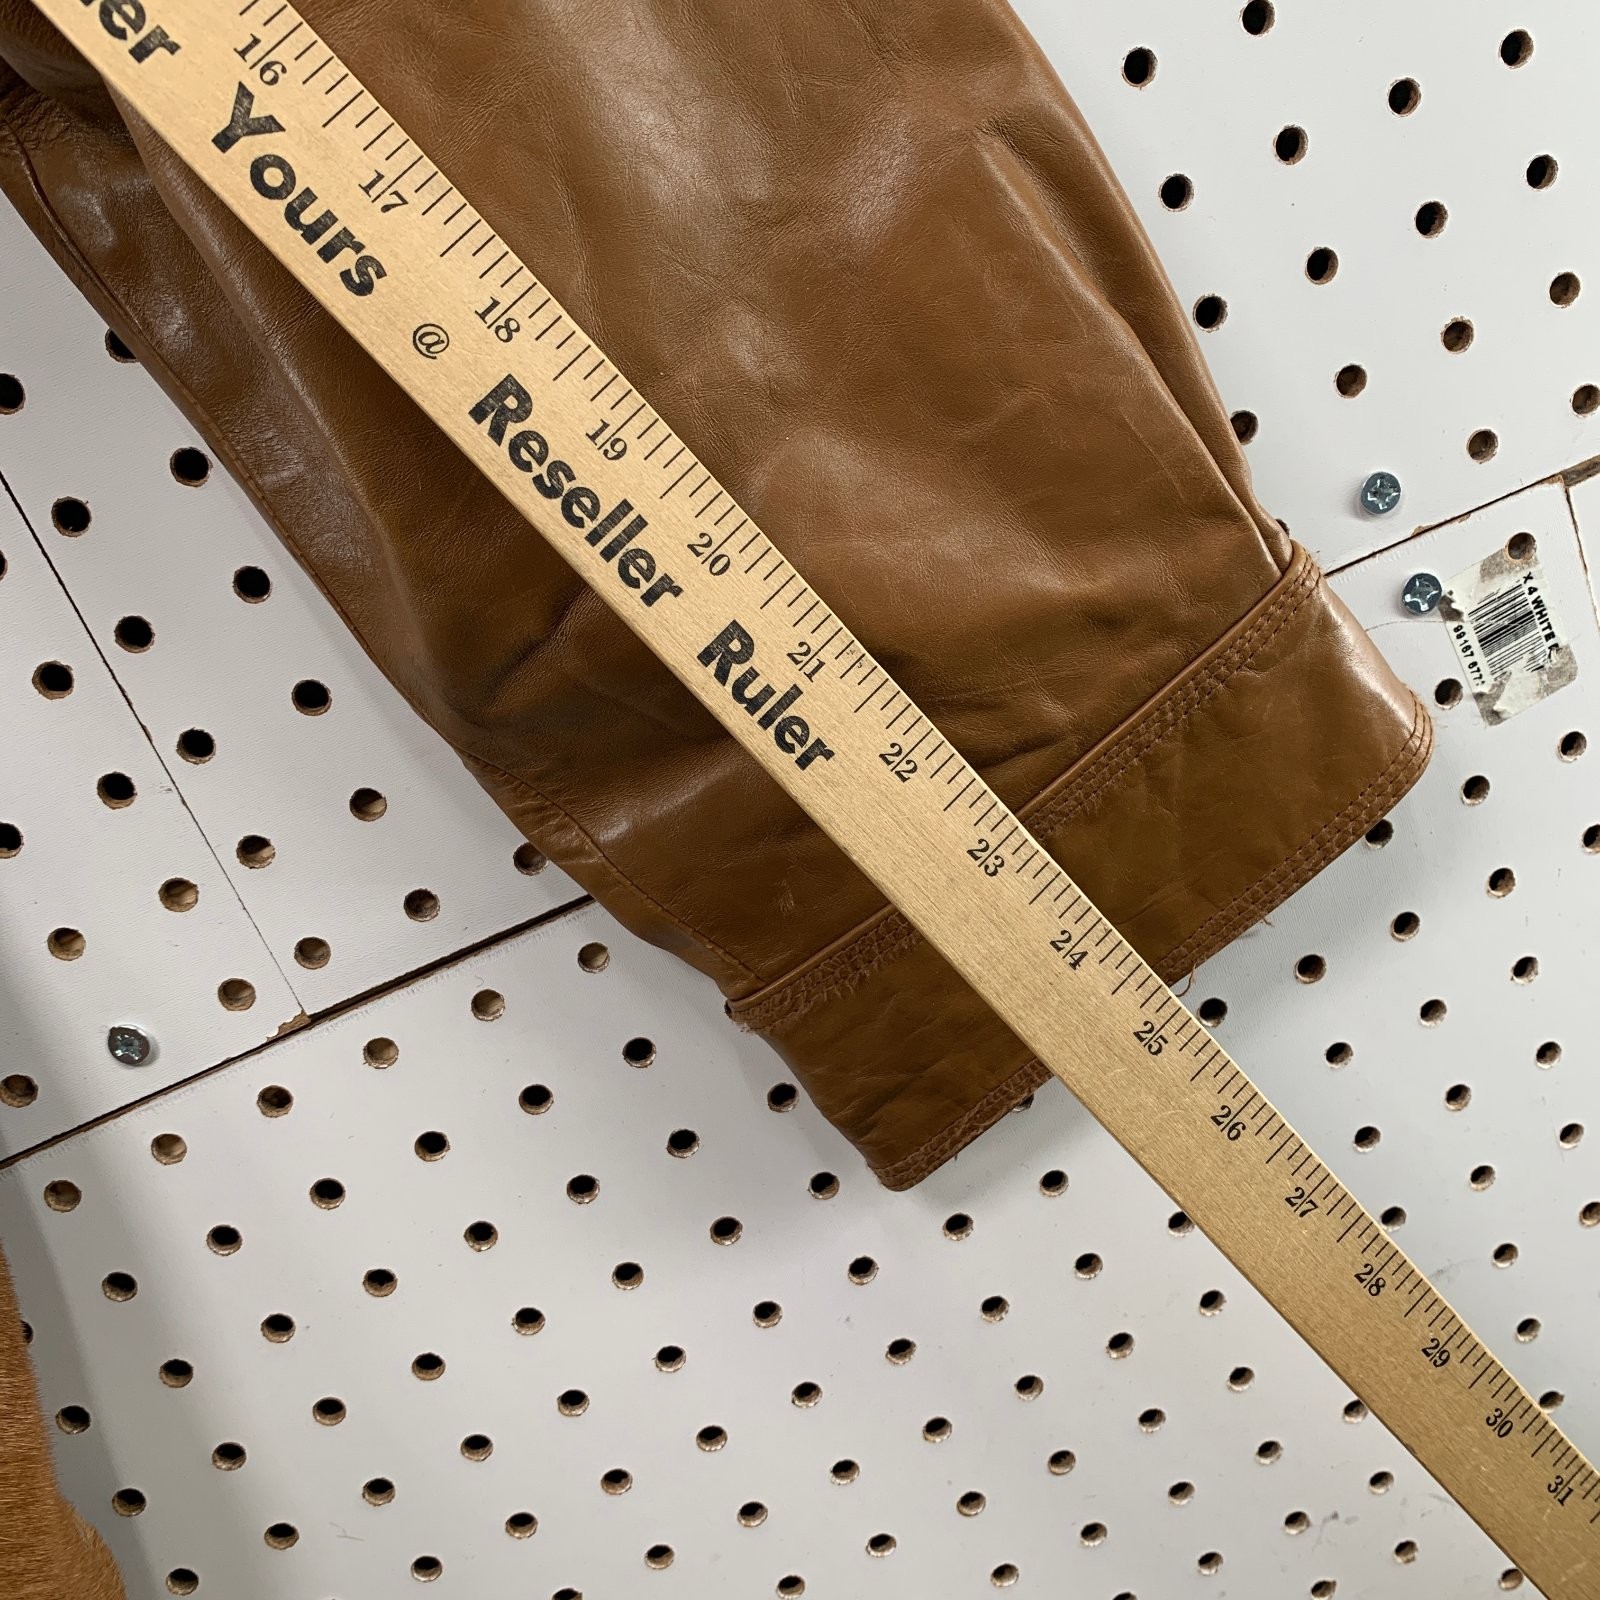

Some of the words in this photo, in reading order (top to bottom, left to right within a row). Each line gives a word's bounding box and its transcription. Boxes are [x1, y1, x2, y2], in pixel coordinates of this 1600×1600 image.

[234, 33, 287, 86] 16
[359, 169, 409, 214] 17
[474, 296, 521, 343] 18
[79, 0, 181, 64] er
[212, 81, 387, 297] Yours
[412, 323, 450, 360] @
[468, 373, 683, 607] Reseller
[697, 619, 835, 771] Ruler
[585, 419, 628, 462] 19
[688, 532, 731, 577] 20
[1531, 595, 1556, 642] WHITE
[787, 641, 826, 683] 21
[879, 742, 917, 783] 22
[967, 839, 1005, 878] 23
[1050, 930, 1089, 971] 24
[1133, 1020, 1169, 1056] 25
[1211, 1105, 1247, 1141] 26
[1285, 1186, 1319, 1219] 27
[1354, 1263, 1386, 1296] 28
[1421, 1337, 1451, 1368] 29
[1486, 1408, 1513, 1438] 30
[1547, 1475, 1575, 1507] 31
